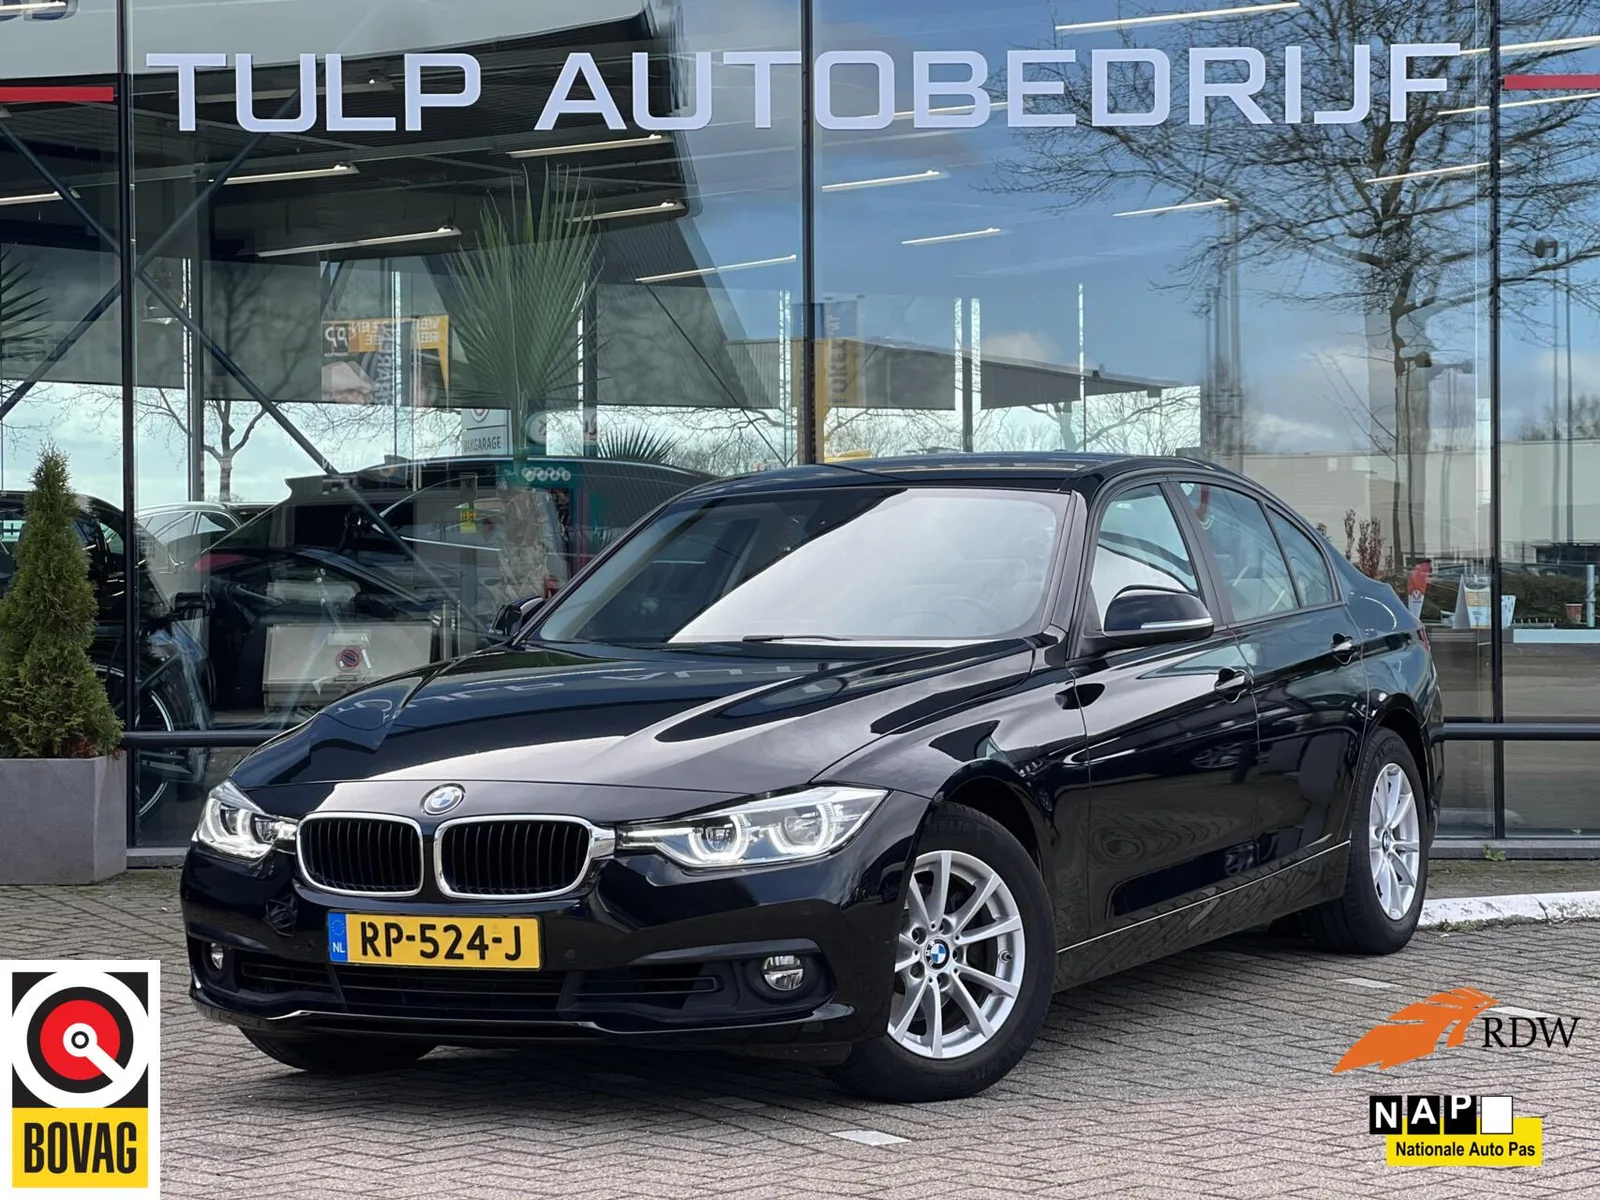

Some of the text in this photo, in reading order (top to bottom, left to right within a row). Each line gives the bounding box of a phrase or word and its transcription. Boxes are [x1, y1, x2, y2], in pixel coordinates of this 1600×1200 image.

[146, 43, 1461, 133] TULP AUTOBEDRIJF
[332, 942, 346, 954] NL
[360, 921, 522, 961] RP-524-J
